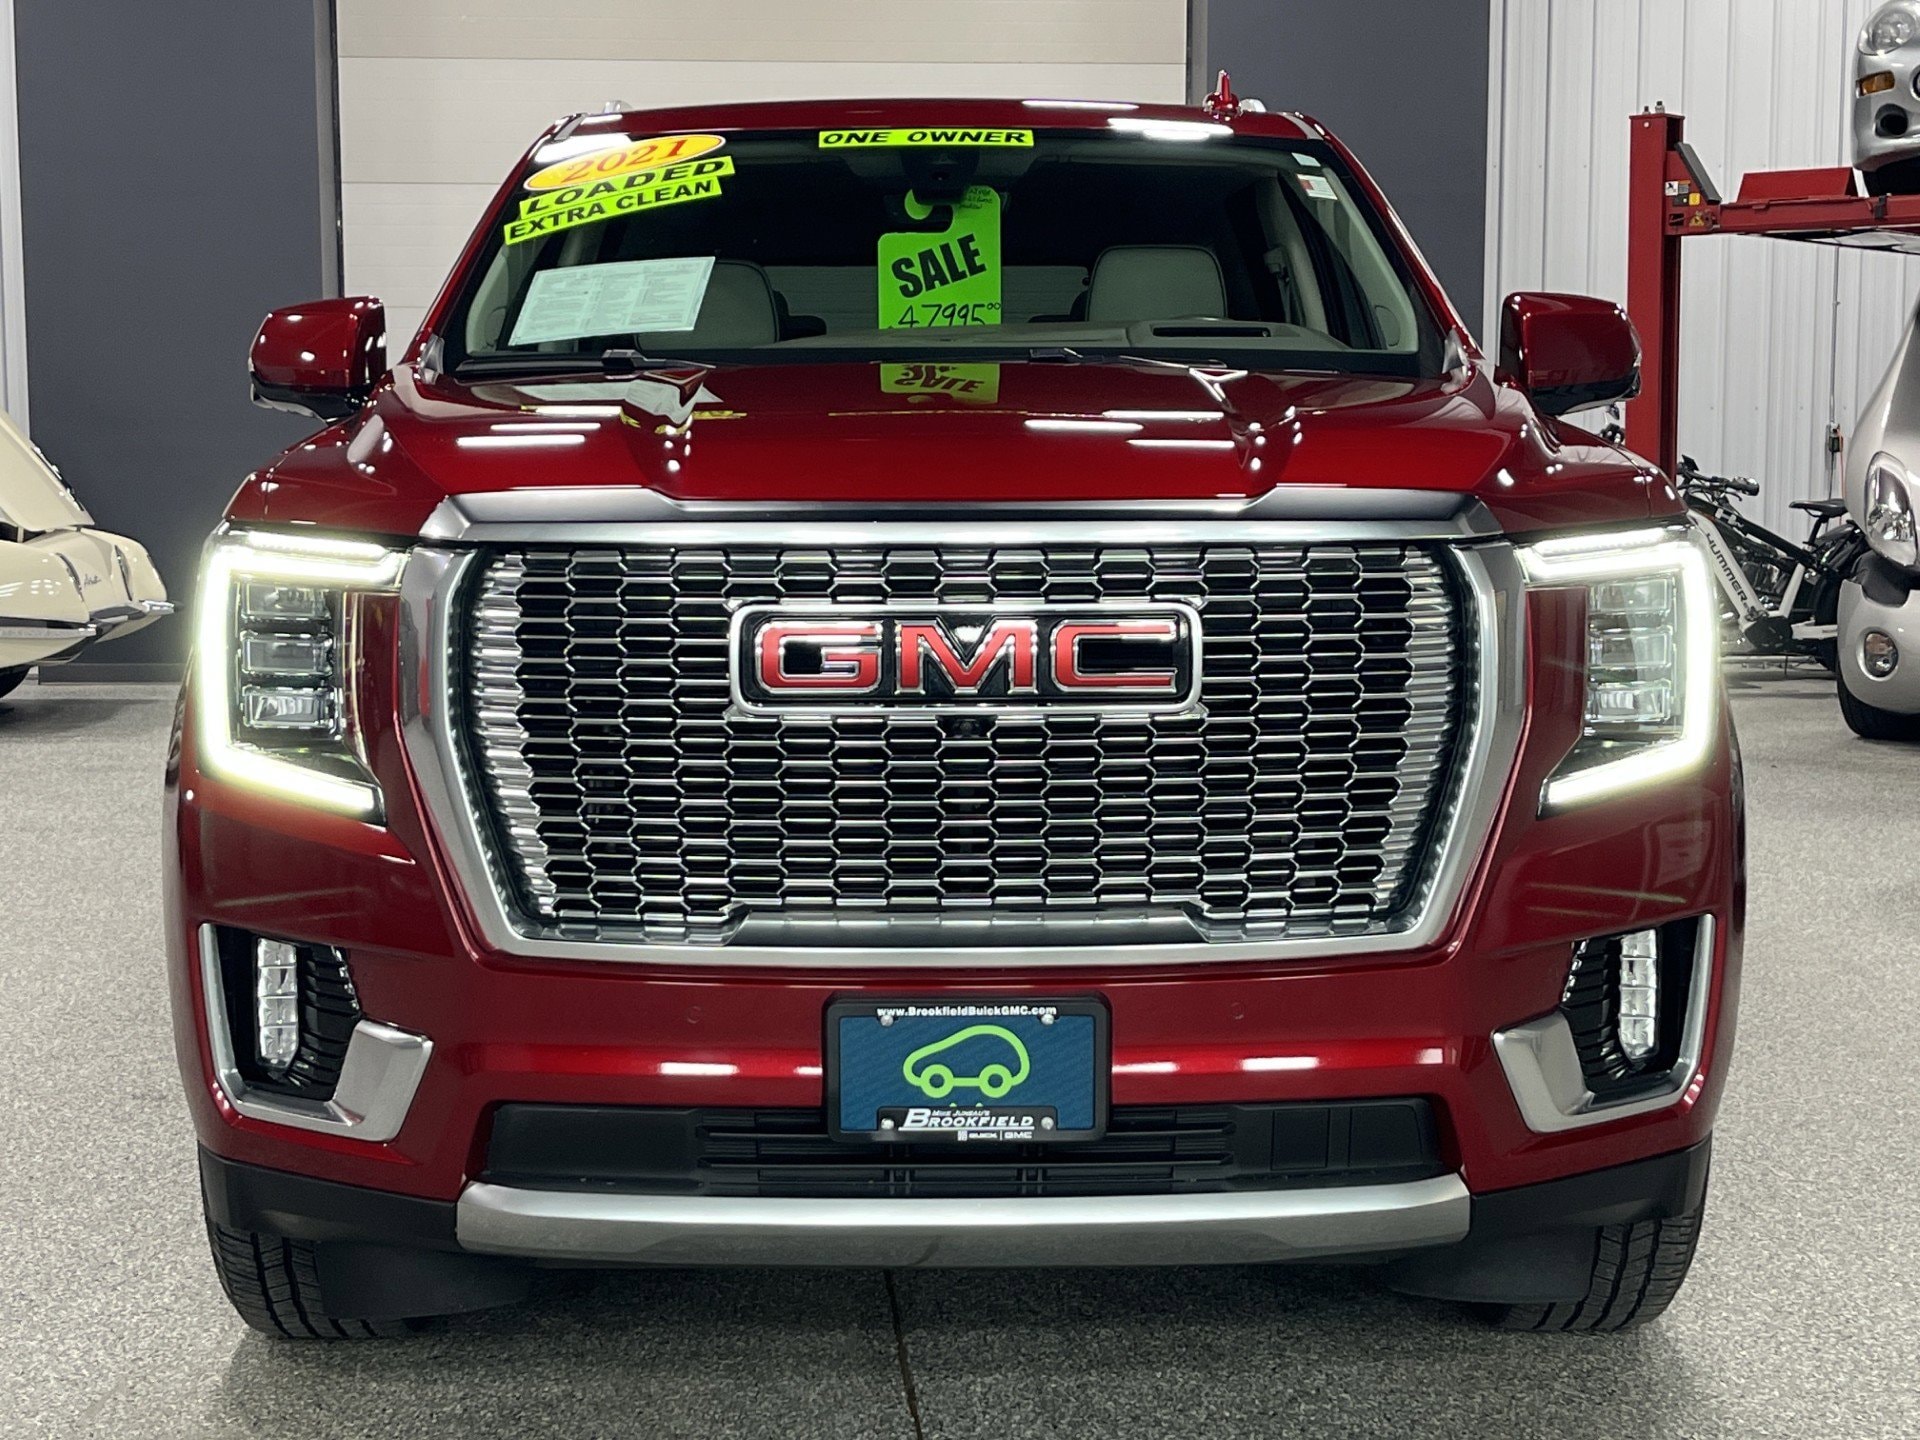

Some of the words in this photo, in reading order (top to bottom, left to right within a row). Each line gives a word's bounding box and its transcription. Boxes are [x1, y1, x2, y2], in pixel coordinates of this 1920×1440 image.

[561, 138, 689, 184] 2021
[822, 131, 891, 145] ONE
[907, 130, 1027, 144] OWNER
[509, 200, 606, 240] EXTRA
[615, 180, 713, 210] CLEAN
[526, 160, 725, 215] LOADED
[890, 233, 988, 299] SALE
[1706, 533, 1748, 602] HUMMER
[755, 617, 1178, 695] GMC
[876, 1005, 1058, 1017] www.BrookfieldBuickGMC.com
[903, 1108, 1035, 1128] BROOKFIELD
[1004, 1130, 1033, 1139] GMC
